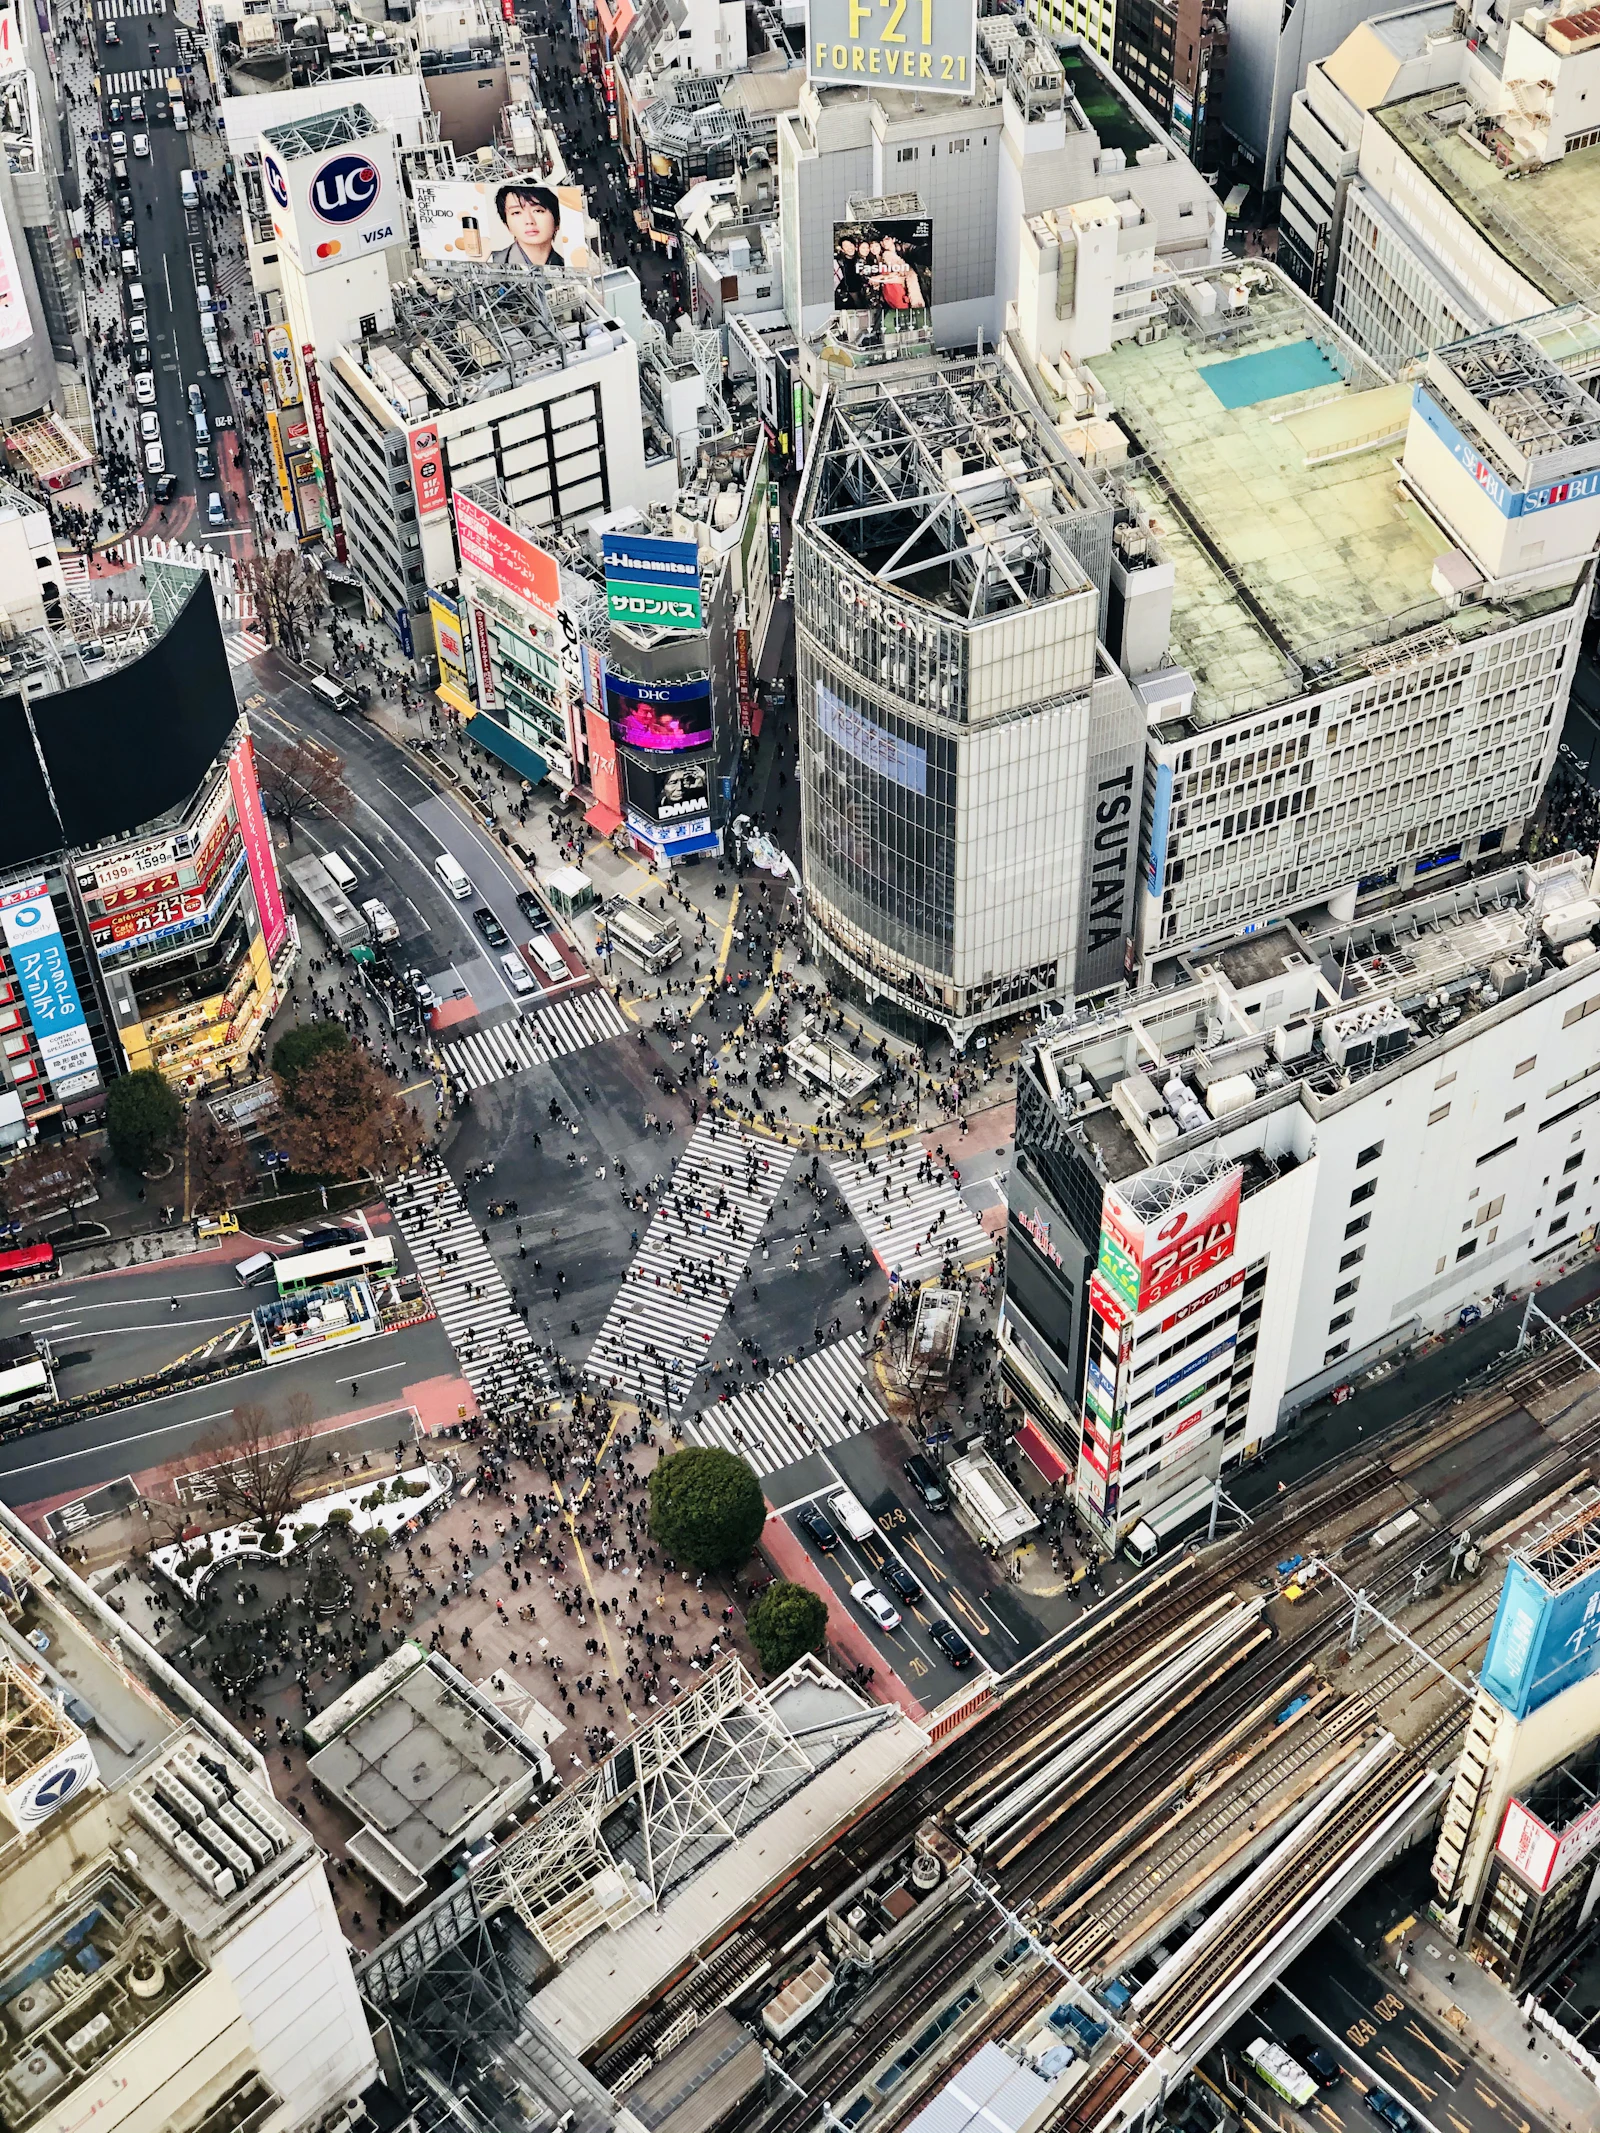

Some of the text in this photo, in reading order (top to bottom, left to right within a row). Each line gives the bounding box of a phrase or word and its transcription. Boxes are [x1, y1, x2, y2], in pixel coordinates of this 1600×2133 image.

[816, 43, 966, 82] FOREVER 21
[419, 208, 454, 218] STUDIO
[361, 226, 393, 244] VISA
[855, 261, 910, 274] Fashion
[1462, 446, 1505, 508] SEIBU
[1524, 475, 1598, 512] SEIBU
[457, 498, 490, 527] わたしの
[460, 526, 535, 582] イルミネーションより
[603, 552, 696, 575] Hisamitsu
[611, 595, 696, 619] サロンパス
[440, 629, 459, 658] 薬
[638, 688, 670, 701] DHC
[658, 797, 708, 820] DMM
[89, 840, 167, 871] しゃぶしゃぶバイキング
[197, 821, 227, 876] コンタクト
[1087, 765, 1134, 954] TSUTAYA
[79, 874, 94, 887] 9F
[136, 853, 172, 871] 1,599円
[157, 894, 190, 912] ガスト
[13, 923, 51, 940] eyecity
[136, 909, 178, 931] ガスト
[93, 931, 111, 943] 7F
[19, 952, 55, 1020] アイシティ
[44, 946, 75, 1015] コンタクトの
[993, 968, 1056, 995] TSUTAYA
[898, 996, 950, 1028] TSUTAYA
[47, 1038, 85, 1053] SPECIALISTS
[50, 1030, 77, 1043] CONTACT
[1103, 1217, 1136, 1265] アコム
[1150, 1221, 1232, 1286] アコム
[1104, 1237, 1138, 1282] レイク
[1101, 1254, 1137, 1298] ALSA
[1192, 1282, 1228, 1311] アイフル
[844, 1505, 860, 1517] 239
[879, 1508, 907, 1531] 8-20
[20, 1784, 36, 1809] TOKYU
[64, 1752, 88, 1763] STORE
[1374, 1993, 1405, 2021] 8-20
[1346, 2019, 1377, 2047] 8-20
